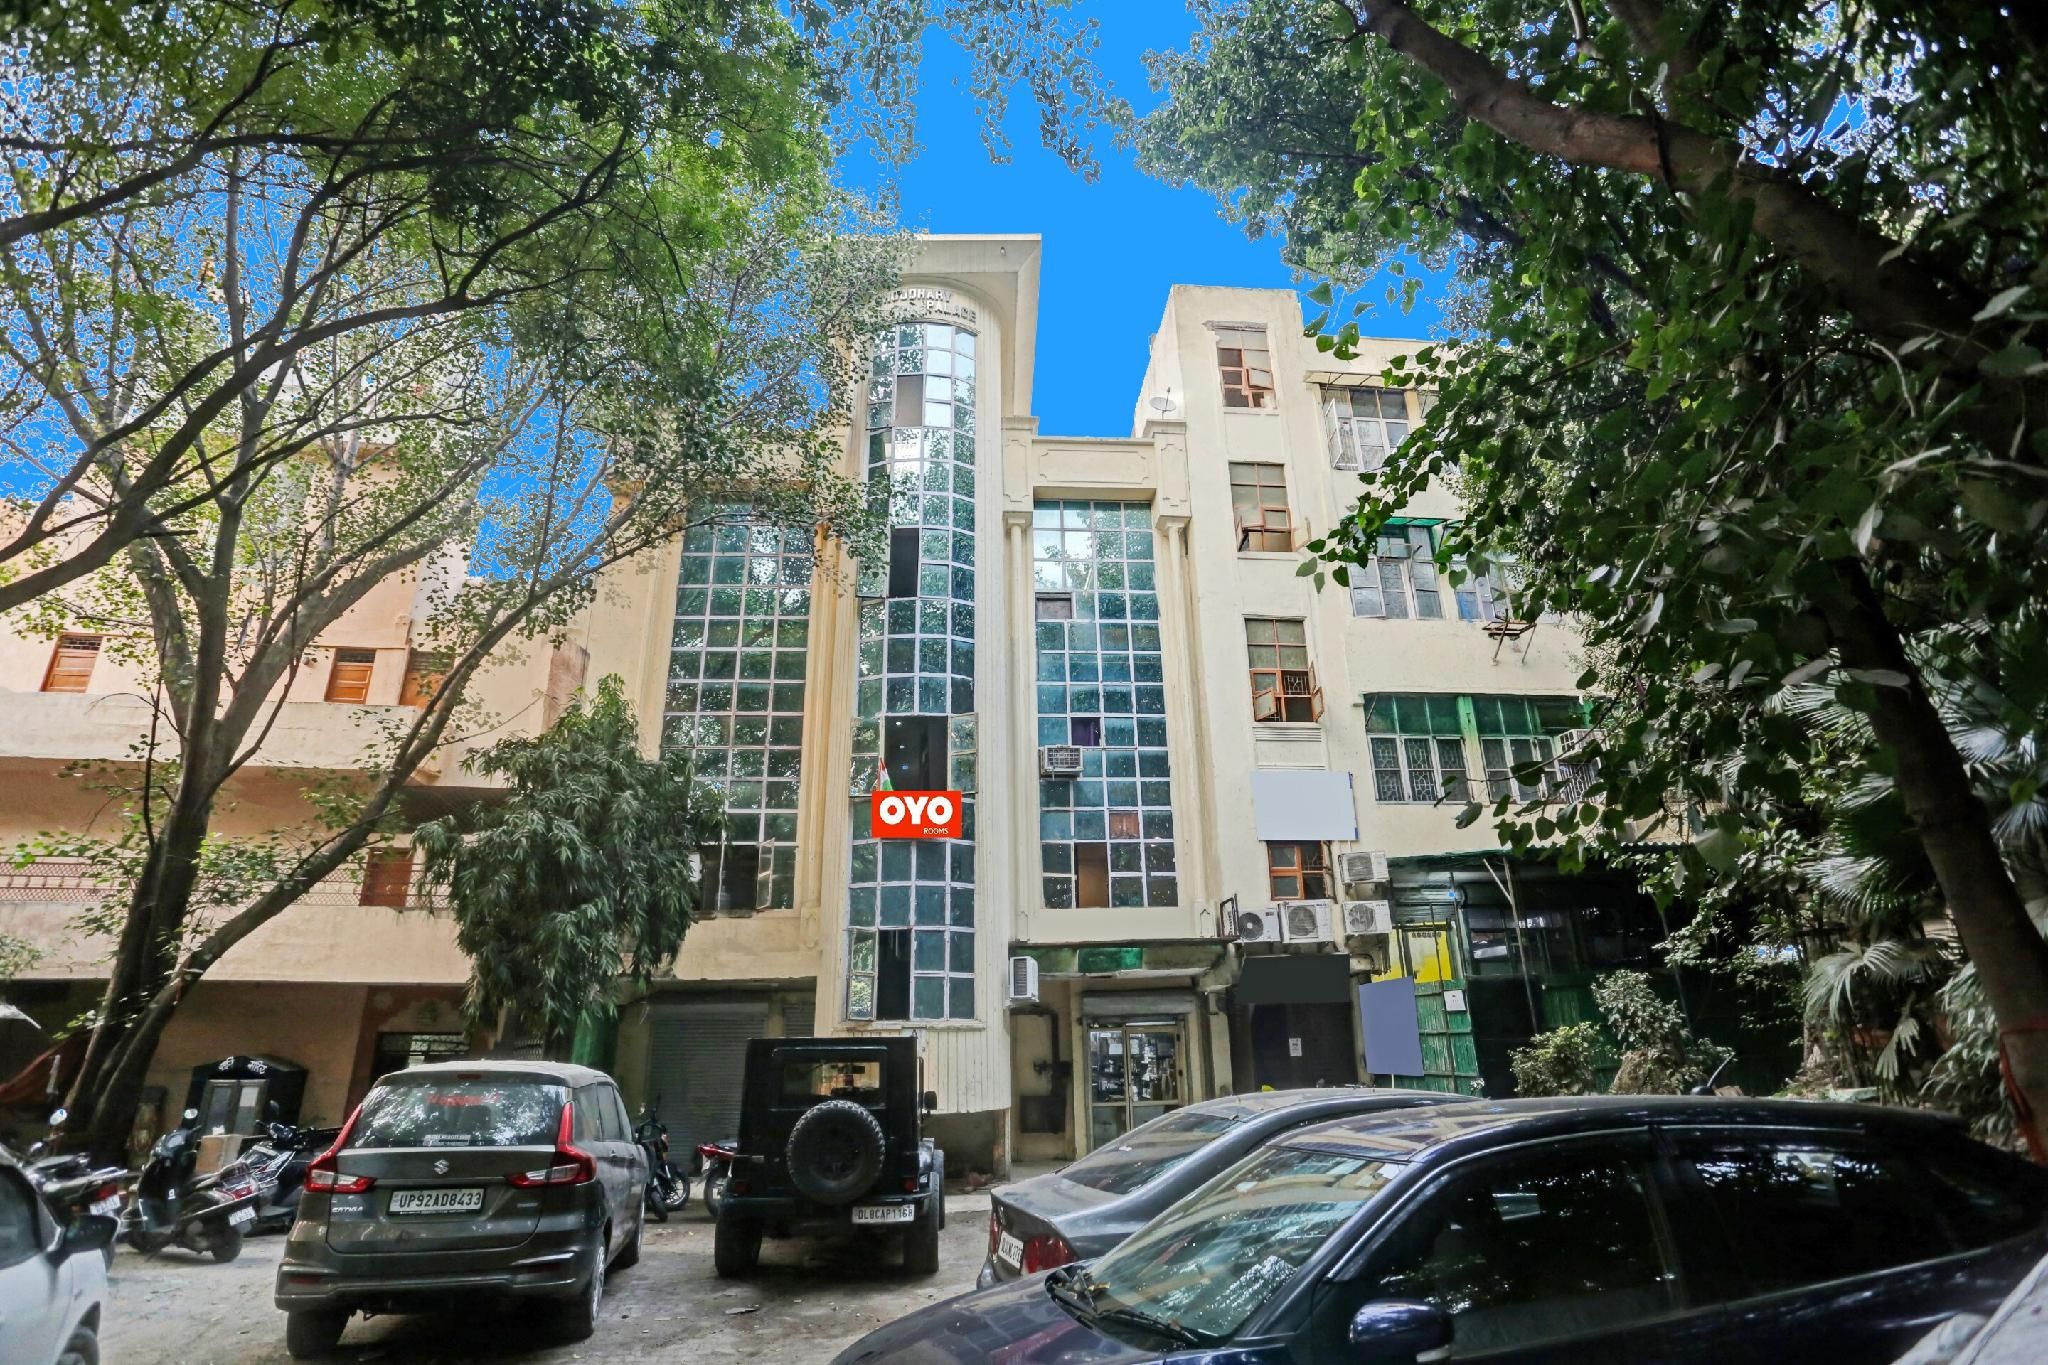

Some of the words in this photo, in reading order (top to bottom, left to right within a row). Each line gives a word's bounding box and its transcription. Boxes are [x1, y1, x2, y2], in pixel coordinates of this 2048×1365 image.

[879, 796, 953, 825] OYO
[923, 827, 949, 835] ROOMS
[400, 1192, 481, 1208] UP92AD8433
